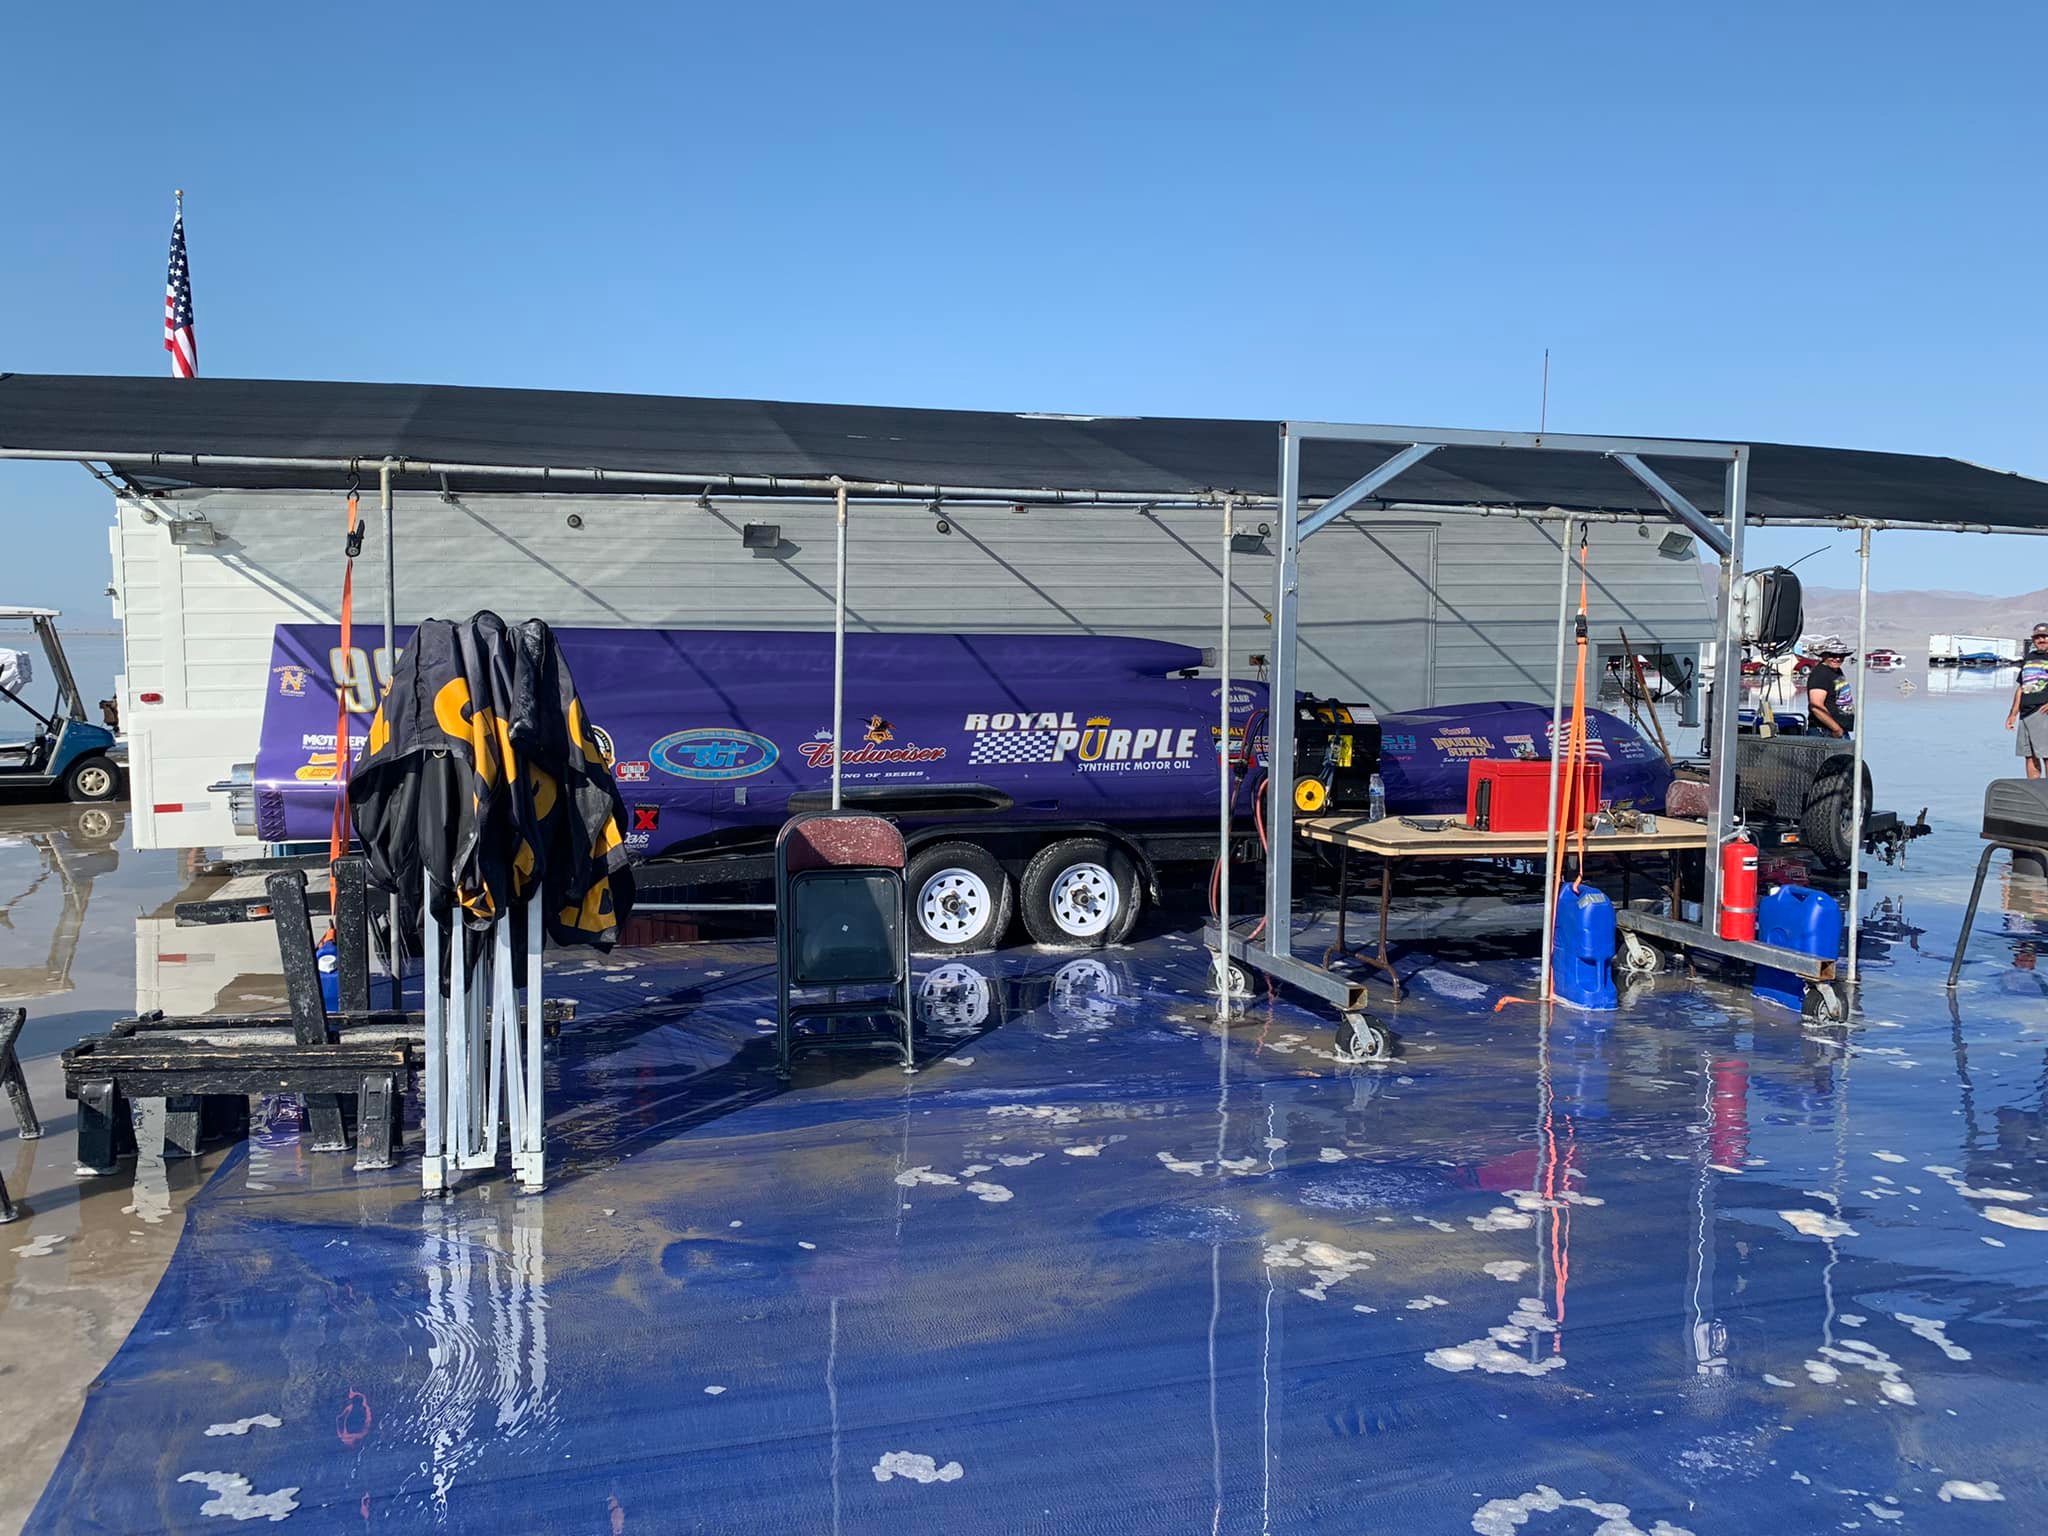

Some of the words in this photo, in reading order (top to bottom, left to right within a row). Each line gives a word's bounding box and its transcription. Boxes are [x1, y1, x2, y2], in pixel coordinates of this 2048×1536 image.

[964, 712, 1077, 730] ROYAL
[1052, 729, 1195, 761] PURPLE
[1431, 736, 1495, 750] INDUSTRIAL
[799, 742, 946, 768] Budweiser
[1448, 747, 1488, 757] SUPPLY
[1077, 762, 1131, 772] SYNTHETIC
[1134, 760, 1170, 770] MOTOR
[1174, 760, 1191, 769] OIL
